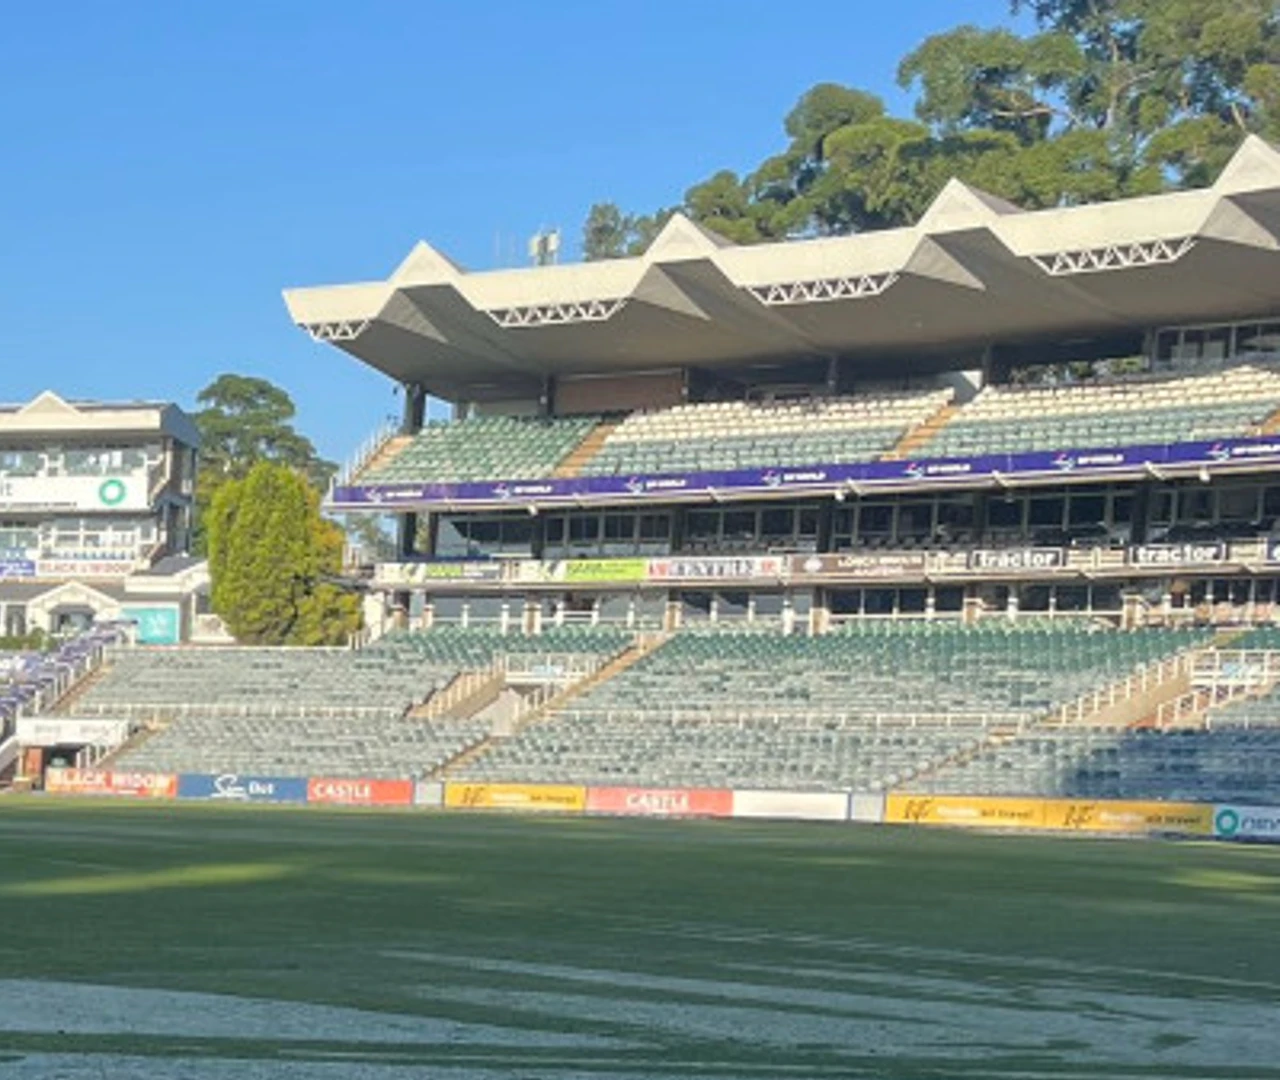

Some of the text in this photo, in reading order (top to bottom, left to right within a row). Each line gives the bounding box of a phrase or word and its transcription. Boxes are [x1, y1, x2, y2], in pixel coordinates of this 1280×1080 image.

[977, 551, 1054, 568] tractor
[1137, 543, 1217, 562] tractor
[314, 782, 371, 798] CASTLE
[625, 793, 690, 811] CASTLE
